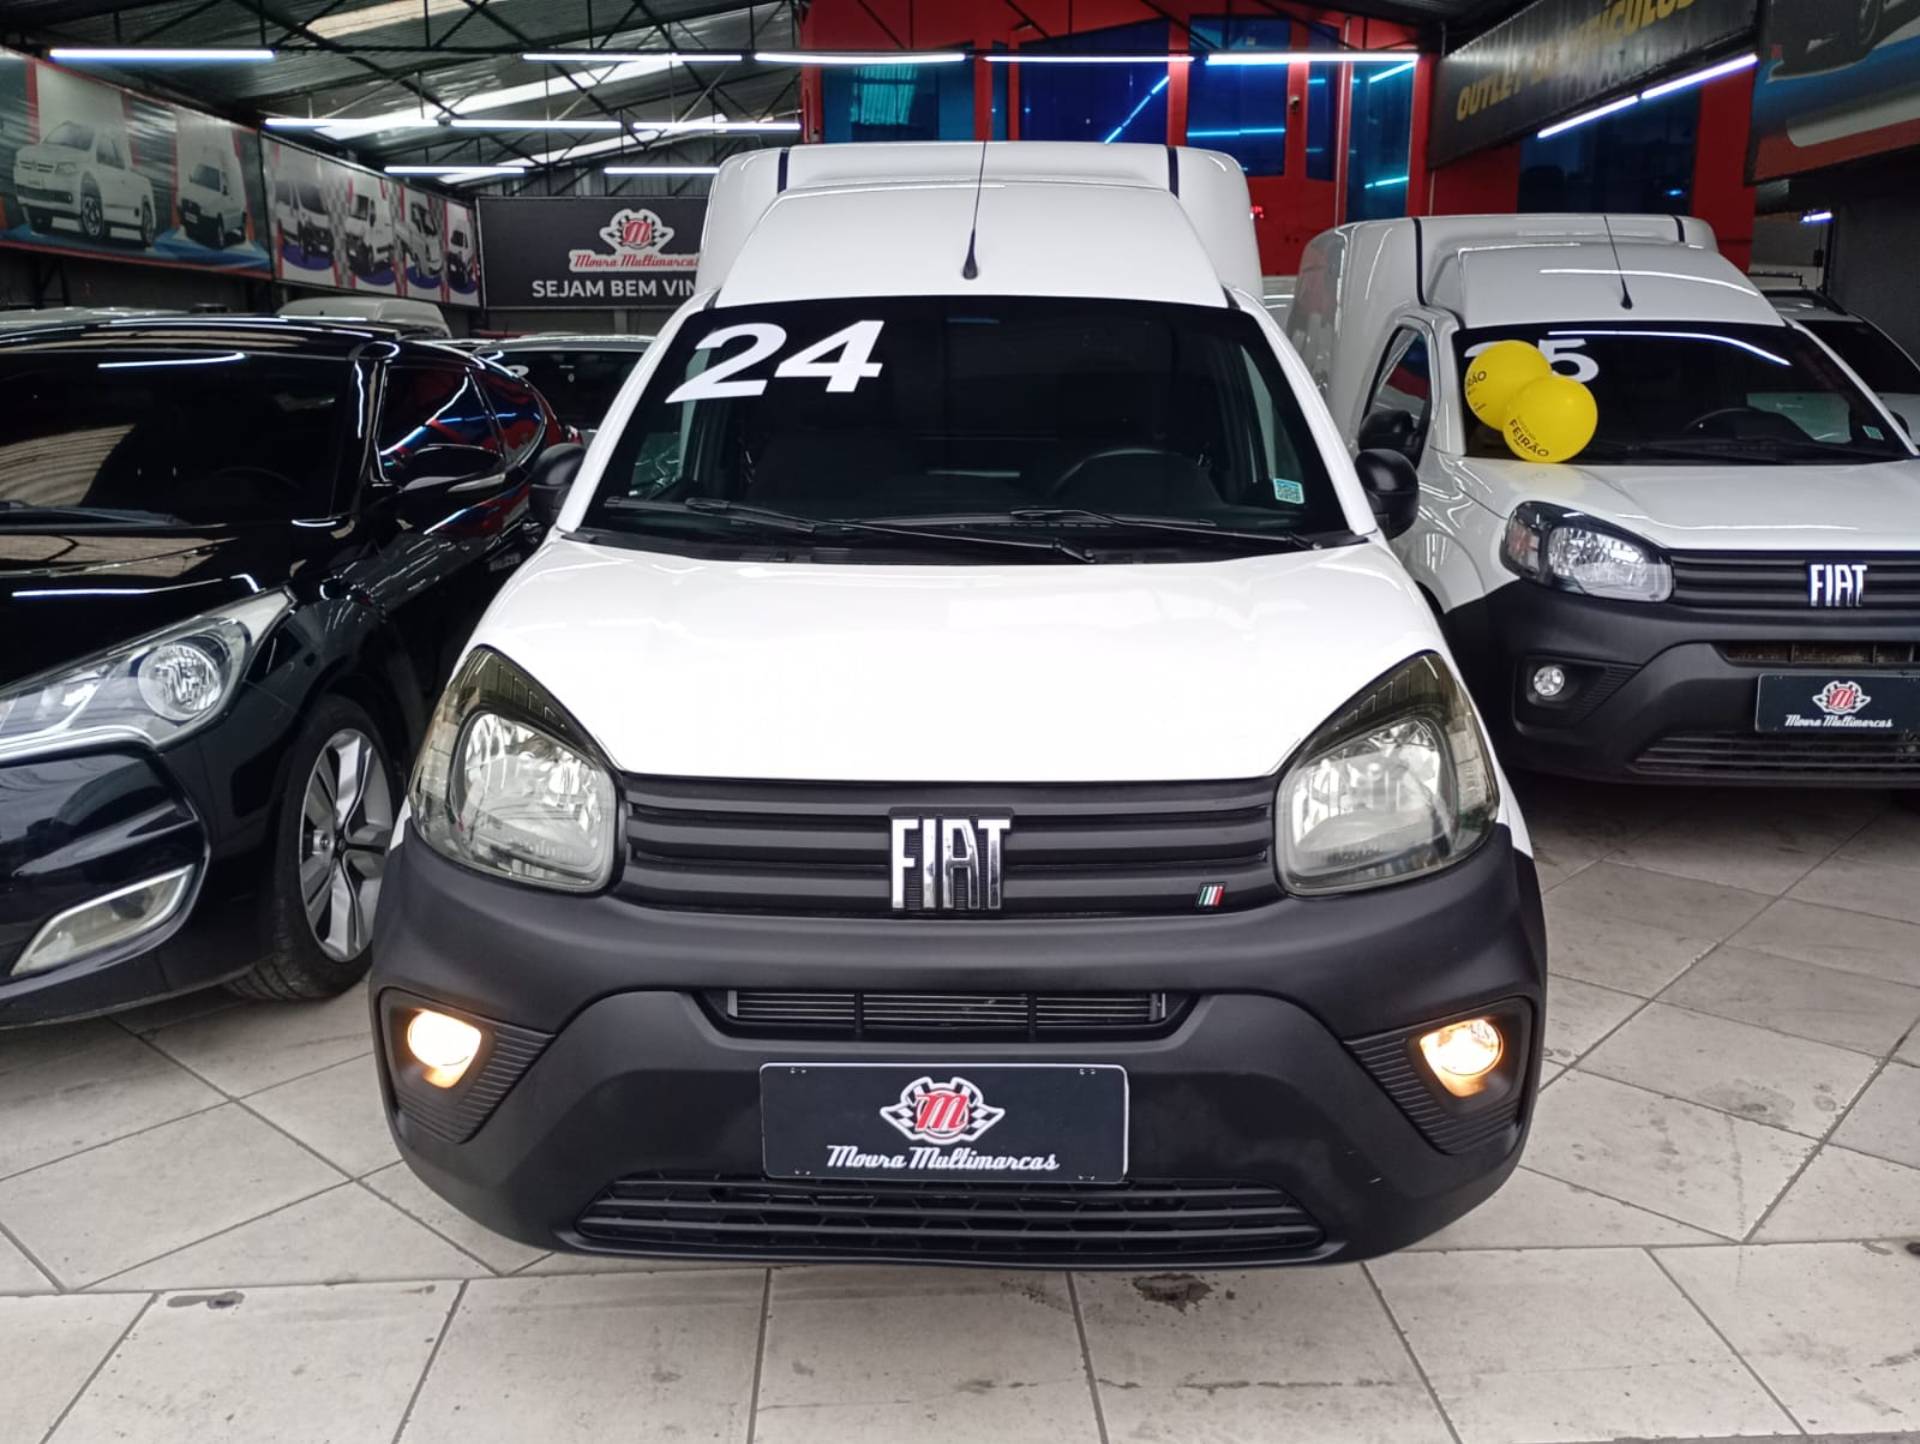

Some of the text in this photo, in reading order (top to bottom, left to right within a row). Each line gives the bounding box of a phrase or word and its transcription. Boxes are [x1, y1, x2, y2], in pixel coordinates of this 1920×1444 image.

[1456, 72, 1522, 121] OUTLET
[574, 254, 616, 267] Moura
[532, 280, 604, 298] SEJAM
[611, 280, 656, 297] BEM
[665, 320, 885, 404] 24
[1464, 338, 1599, 384] 5
[1508, 418, 1550, 458] FEIRÃO
[1810, 564, 1868, 607] FIAT
[1784, 714, 1893, 729] Moura Multimarcas
[892, 818, 1011, 910] FIAT
[826, 1145, 1061, 1171] Moura Multimarcas
